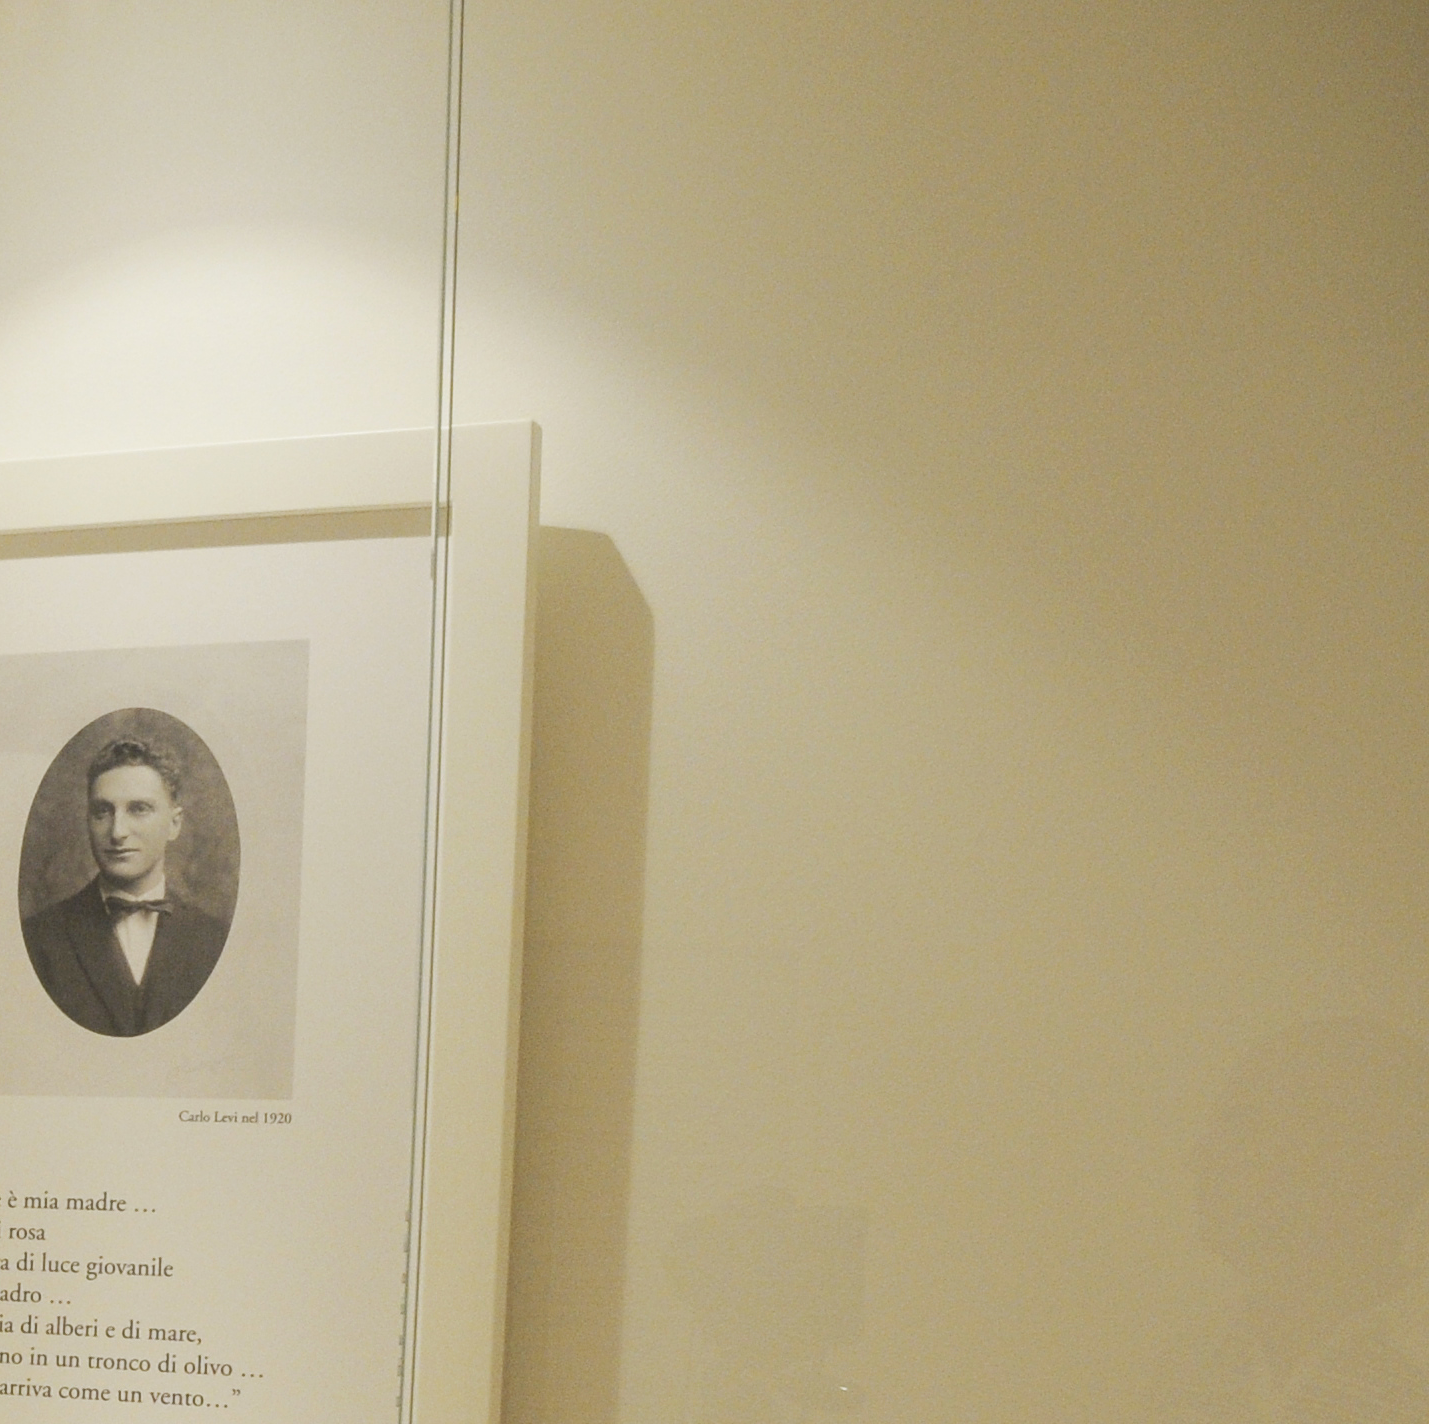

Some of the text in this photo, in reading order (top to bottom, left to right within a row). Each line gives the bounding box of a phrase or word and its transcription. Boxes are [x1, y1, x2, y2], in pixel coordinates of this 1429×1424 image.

[179, 1110, 292, 1124] Carlo Levi nel 1920
[8, 1191, 17, 1208] è
[24, 1191, 58, 1209] mia
[66, 1191, 126, 1212] madre
[9, 1227, 45, 1240] rosa
[16, 1252, 34, 1271] di
[42, 1252, 80, 1273] luce
[86, 1256, 173, 1279] giovanile
[20, 1315, 38, 1334] di
[46, 1316, 97, 1337] alberi
[105, 1326, 115, 1338] e
[122, 1319, 140, 1339] di
[148, 1328, 201, 1344] mare,
[30, 1350, 47, 1366] in
[56, 1355, 79, 1368] un
[88, 1356, 151, 1371] tronco
[158, 1353, 176, 1373] di
[184, 1355, 233, 1376] olivo
[0, 1378, 52, 1398] arriva
[59, 1387, 110, 1401] come
[118, 1390, 142, 1403] un
